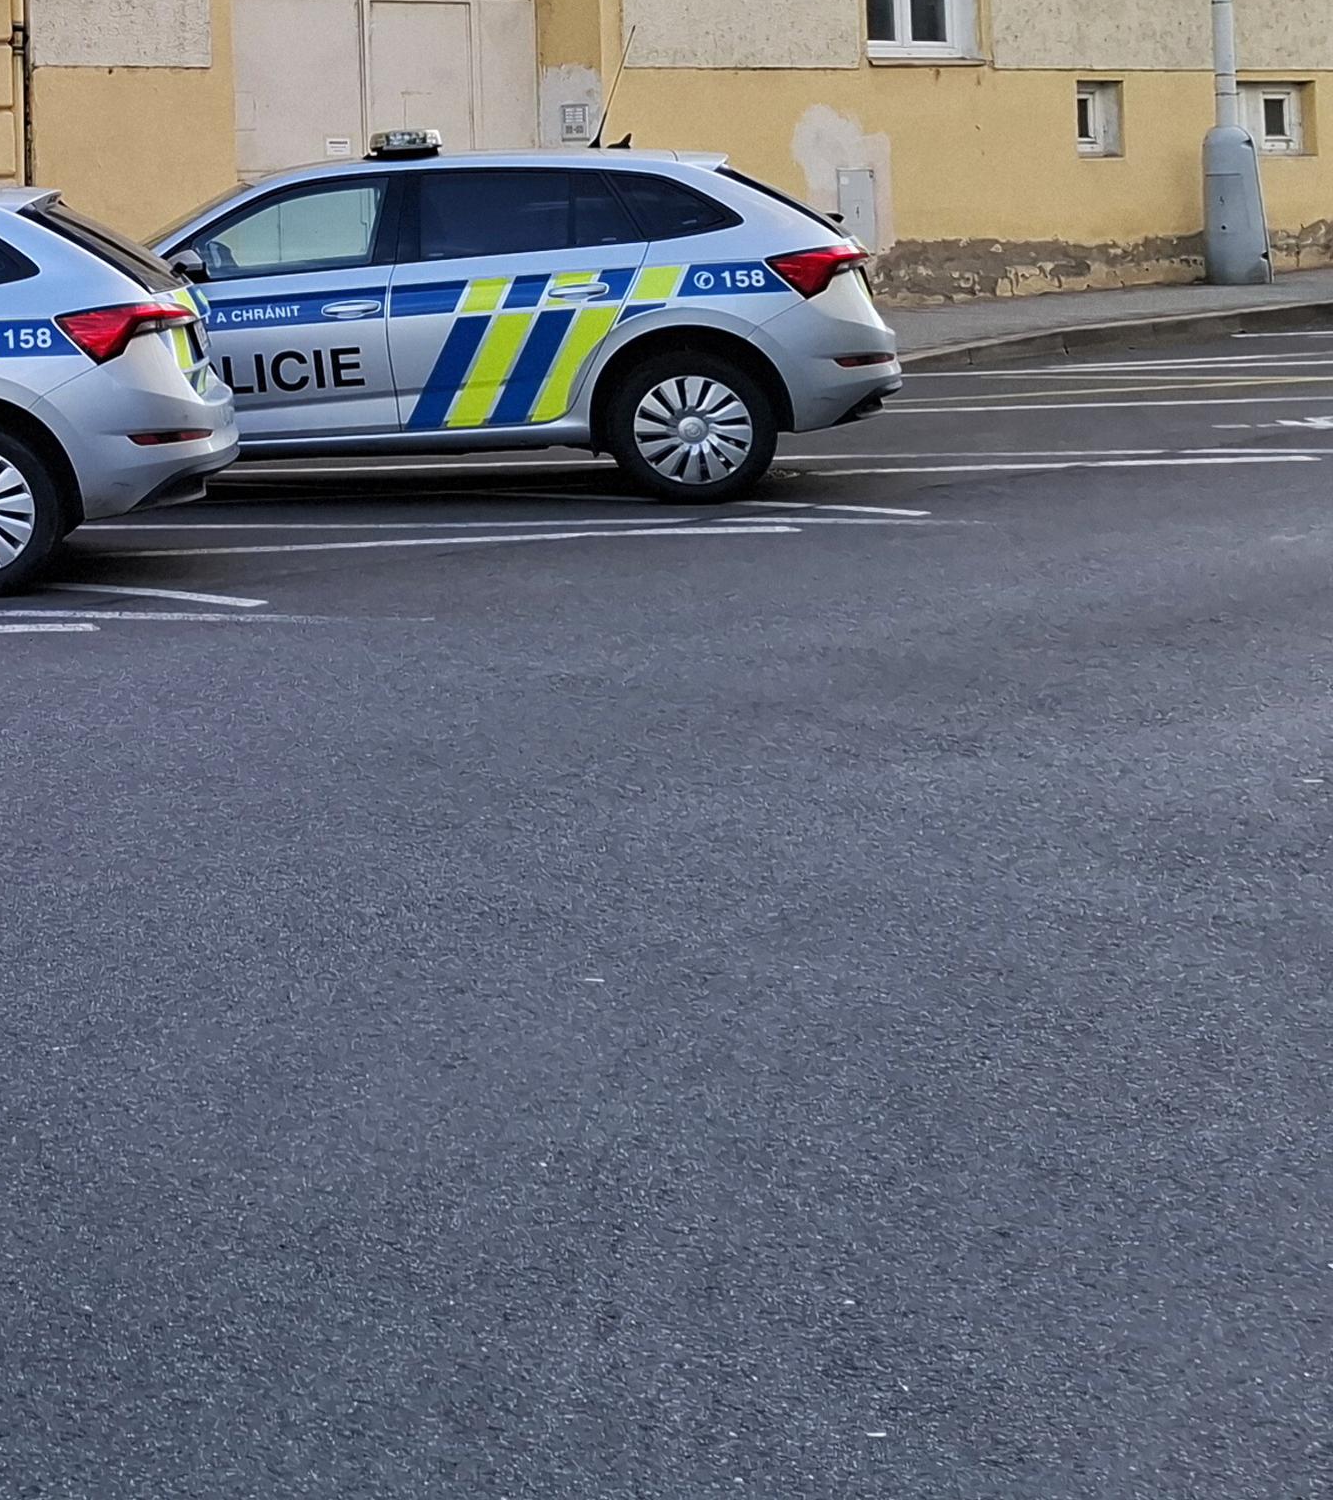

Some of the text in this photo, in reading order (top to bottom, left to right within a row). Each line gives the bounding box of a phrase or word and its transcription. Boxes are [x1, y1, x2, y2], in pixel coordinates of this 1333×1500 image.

[720, 269, 766, 288] 158
[215, 311, 228, 323] A
[232, 304, 301, 322] CHRÁNIT
[2, 327, 53, 350] 158
[211, 346, 366, 395] LICIE
